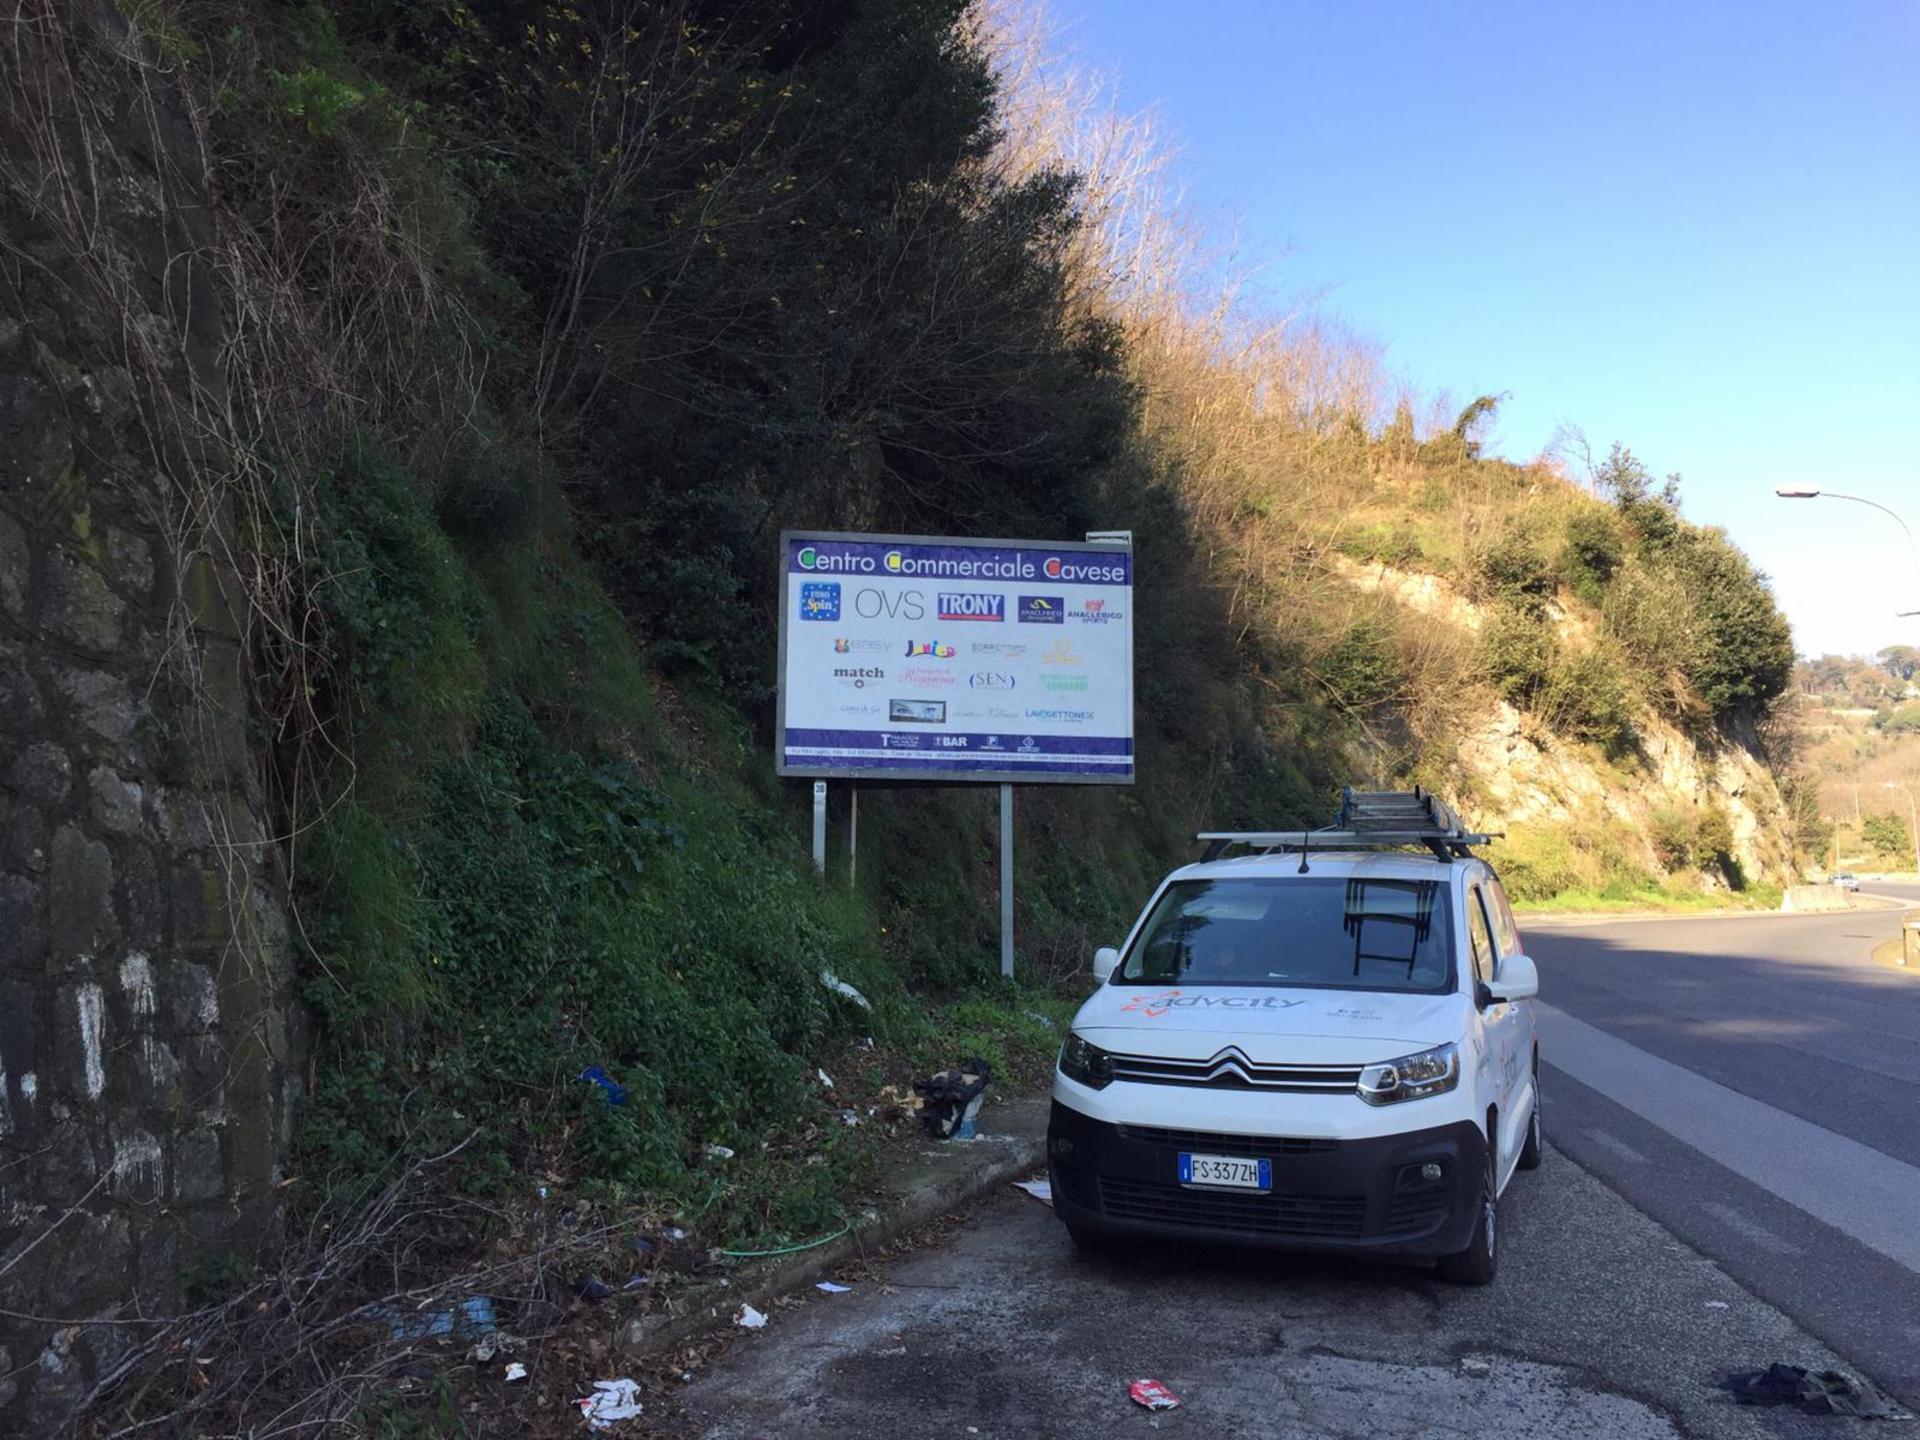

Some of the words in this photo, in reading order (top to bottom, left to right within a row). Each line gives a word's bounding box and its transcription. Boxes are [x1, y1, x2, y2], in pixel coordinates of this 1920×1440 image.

[798, 547, 875, 571] Centro
[884, 551, 1035, 578] Commerciale
[1043, 557, 1125, 582] Cavese
[807, 598, 833, 613] Spin
[855, 588, 925, 620] OVS
[940, 593, 1001, 615] TRONY
[1067, 611, 1123, 619] ANACLERICO
[833, 667, 885, 679] match
[943, 736, 968, 747] BAR
